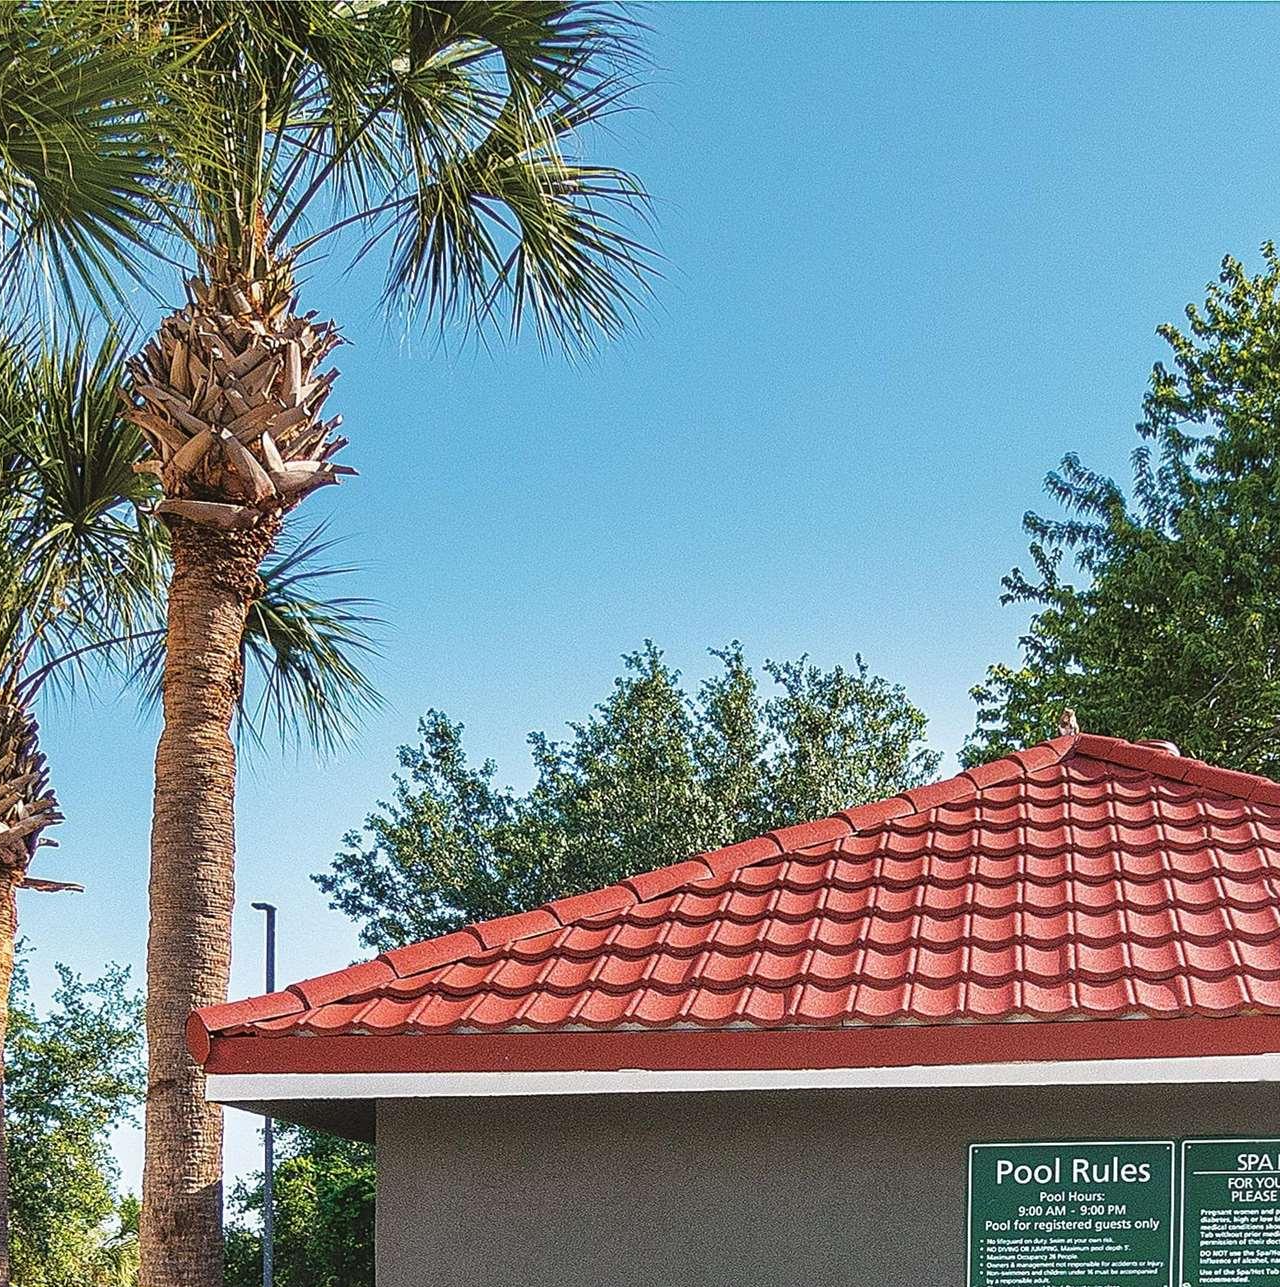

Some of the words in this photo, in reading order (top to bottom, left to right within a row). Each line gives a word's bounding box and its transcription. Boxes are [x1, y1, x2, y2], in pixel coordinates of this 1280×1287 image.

[1238, 1154, 1272, 1170] SPA
[997, 1158, 1060, 1184] Pool
[1073, 1156, 1150, 1183] Rules
[1228, 1178, 1253, 1189] FOR
[1040, 1191, 1065, 1202] Pool
[1068, 1191, 1105, 1202] Hours:
[1232, 1190, 1277, 1202] PLEASE
[1018, 1206, 1043, 1216] 9:00
[1045, 1206, 1066, 1216] AM
[1080, 1205, 1105, 1215] 9:00
[1108, 1205, 1126, 1215] PM
[985, 1220, 1010, 1231] Pool
[1014, 1219, 1031, 1230] for
[1034, 1219, 1092, 1232] registered
[1095, 1220, 1131, 1232] guests
[1134, 1218, 1160, 1231] only
